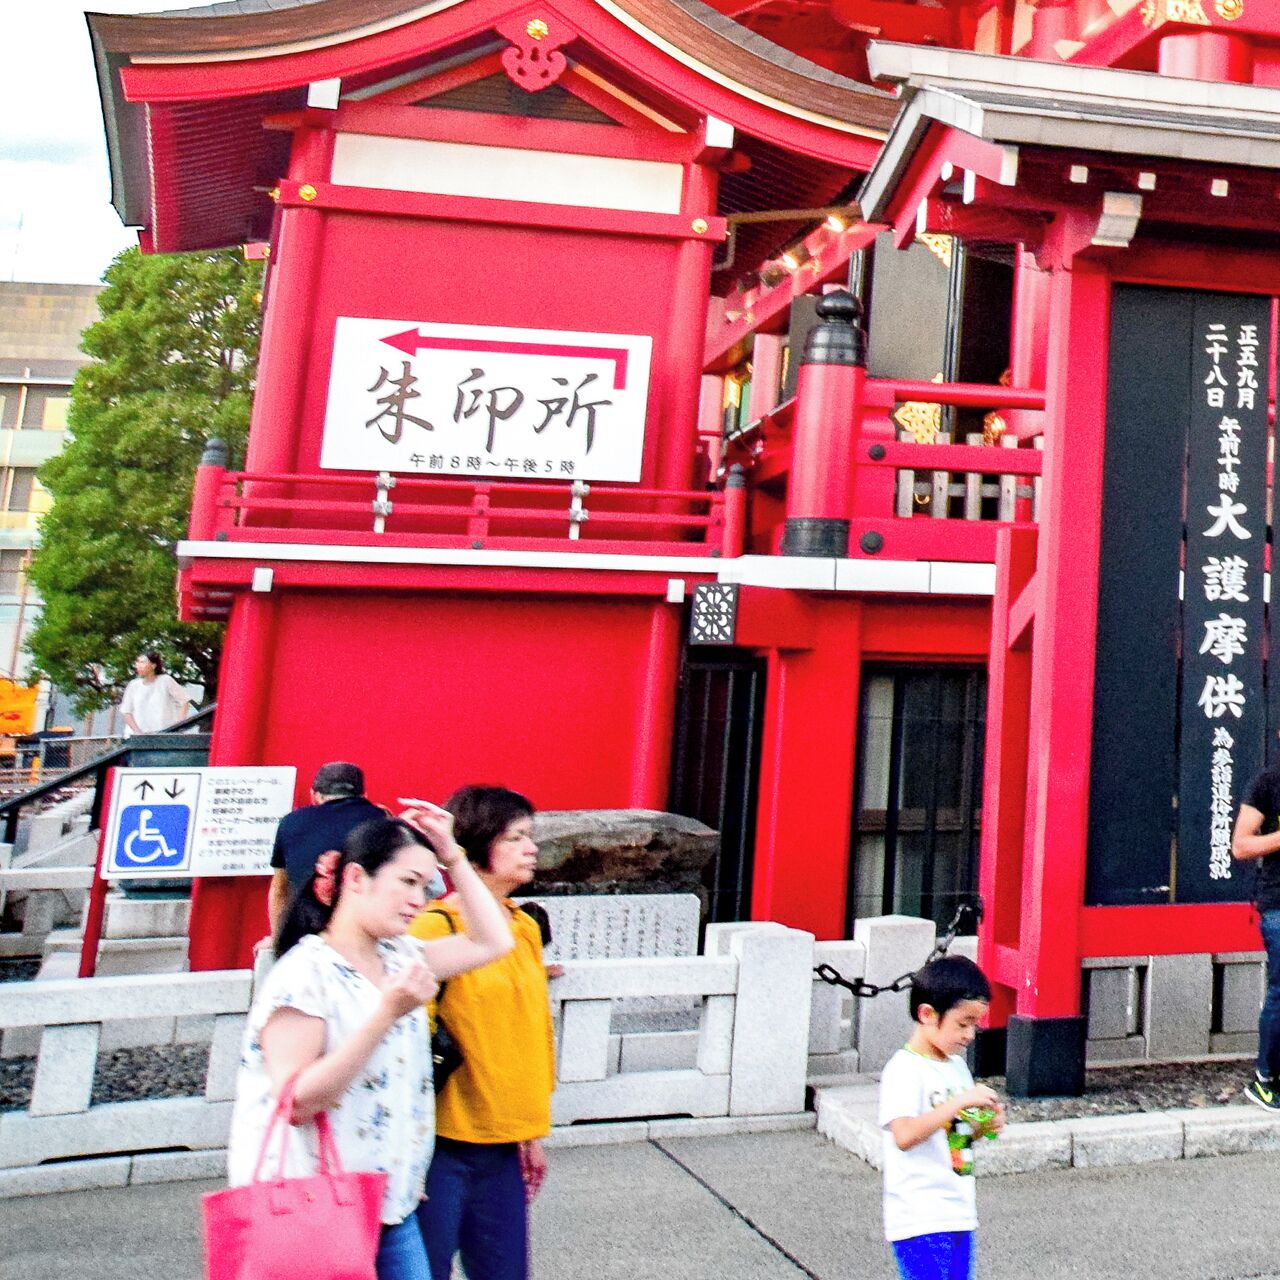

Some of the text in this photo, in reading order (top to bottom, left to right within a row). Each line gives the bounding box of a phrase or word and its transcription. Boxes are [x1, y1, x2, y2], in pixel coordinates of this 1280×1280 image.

[366, 360, 613, 456] 朱印所
[1204, 323, 1229, 409] 二十八日
[1237, 324, 1259, 410] 正五九月
[1217, 415, 1242, 493] 午前十時
[1198, 493, 1252, 719] 大護摩供
